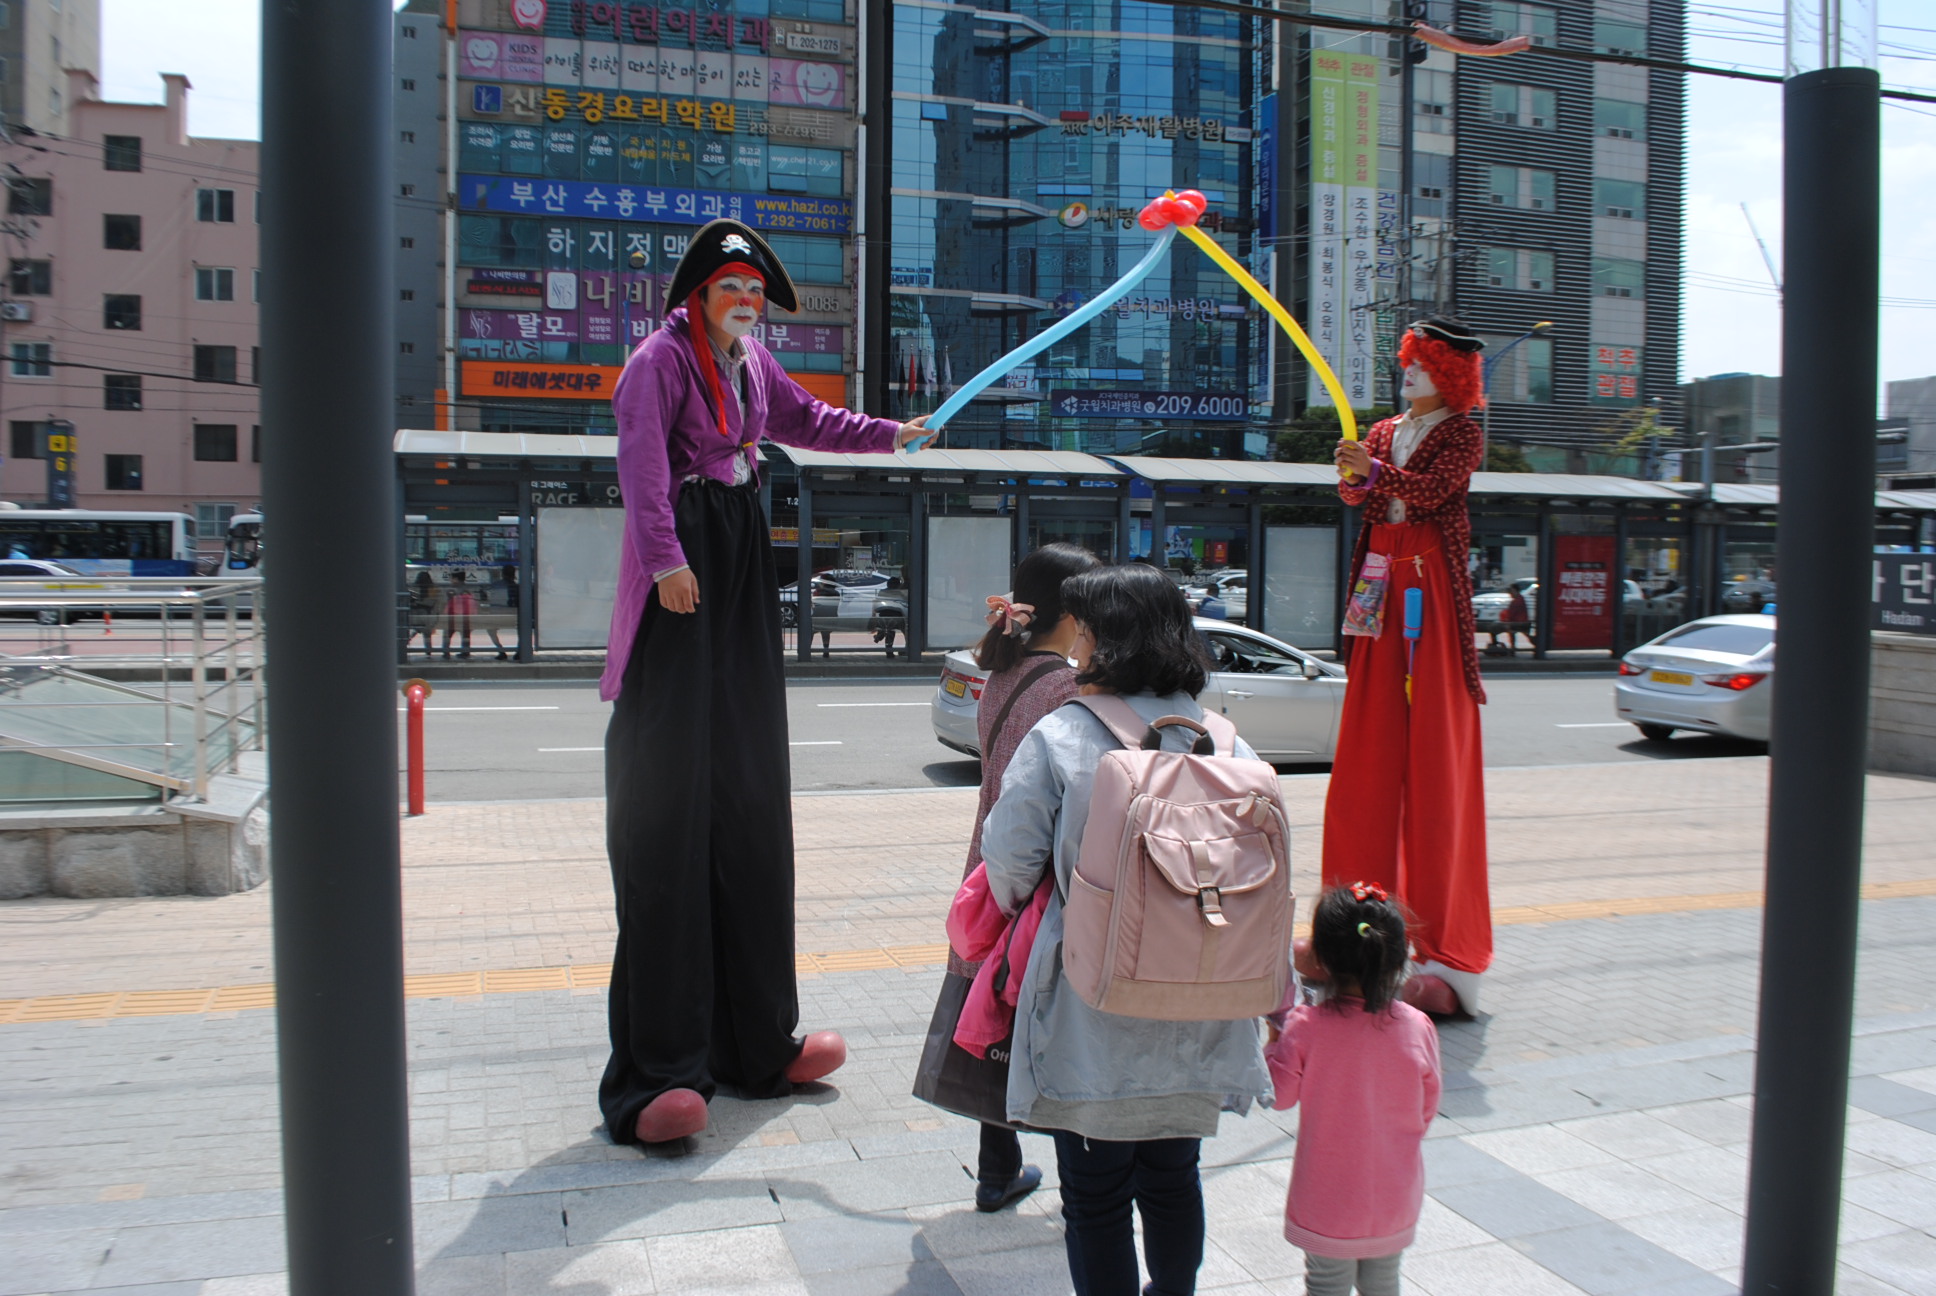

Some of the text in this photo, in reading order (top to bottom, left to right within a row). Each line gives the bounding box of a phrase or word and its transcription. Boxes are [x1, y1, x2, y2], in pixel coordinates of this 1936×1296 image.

[592, 2, 772, 50] 어린이치과
[508, 43, 537, 55] KIDS
[545, 52, 581, 77] 아이를
[589, 55, 619, 76] 위한
[628, 59, 677, 81] 따스한
[681, 63, 723, 85] 마음이
[736, 66, 762, 88] 있는
[1060, 122, 1088, 136] ARC
[1094, 112, 1224, 140] 아주재활병원
[510, 181, 568, 212] 부산
[516, 312, 566, 338] 탈모
[493, 370, 603, 391] 미래에셋대우
[1080, 396, 1244, 416] 굿월치과병원 209.6000
